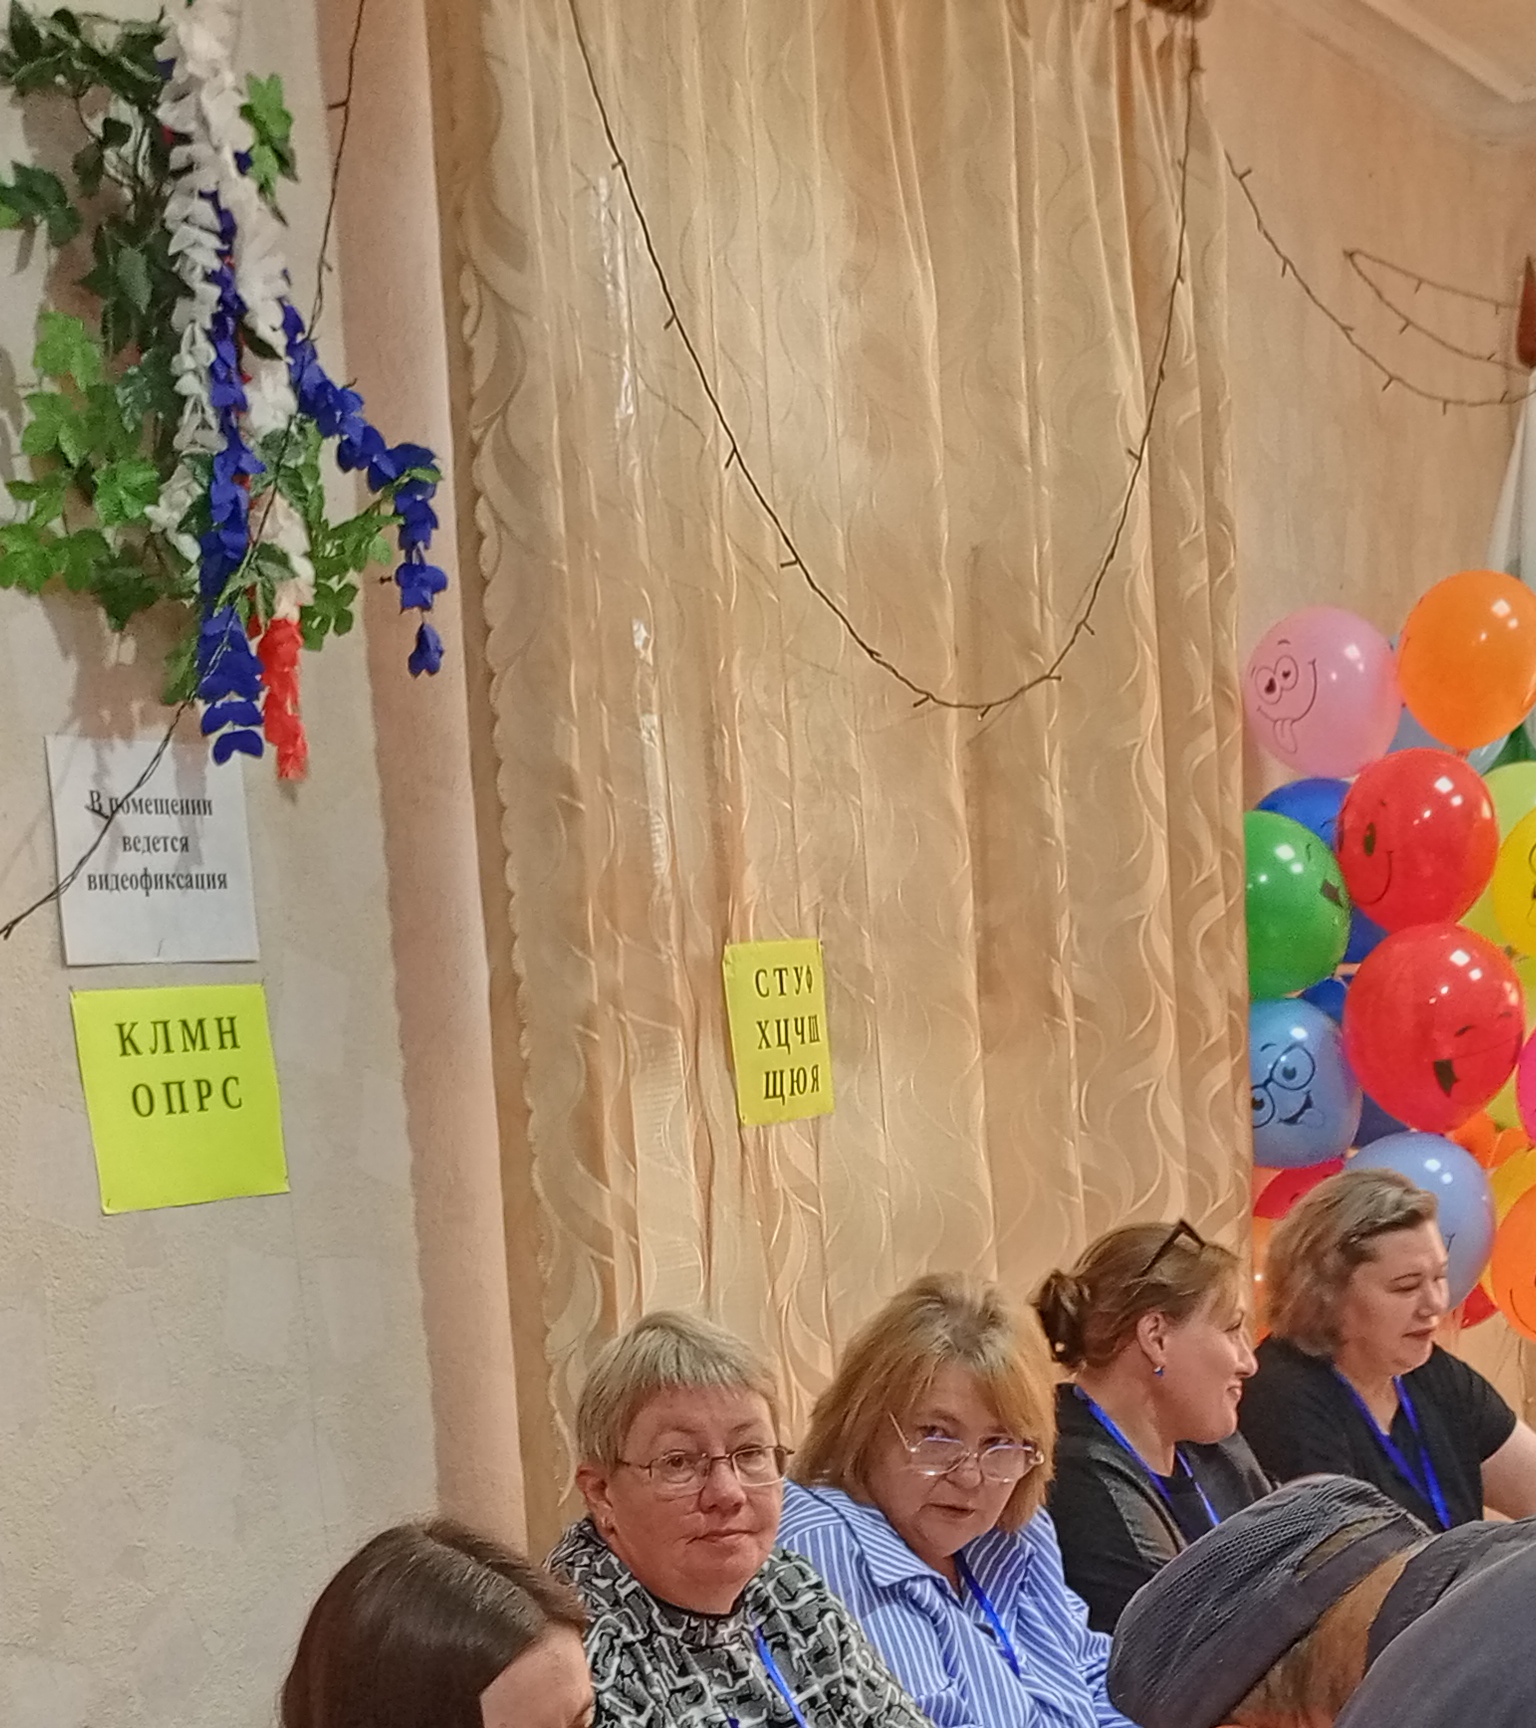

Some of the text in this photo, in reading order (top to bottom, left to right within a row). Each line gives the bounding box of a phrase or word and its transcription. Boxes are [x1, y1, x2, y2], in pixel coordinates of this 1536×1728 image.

[89, 790, 213, 817] В помещении
[122, 834, 189, 853] ведется
[86, 872, 227, 895] видеофиксация
